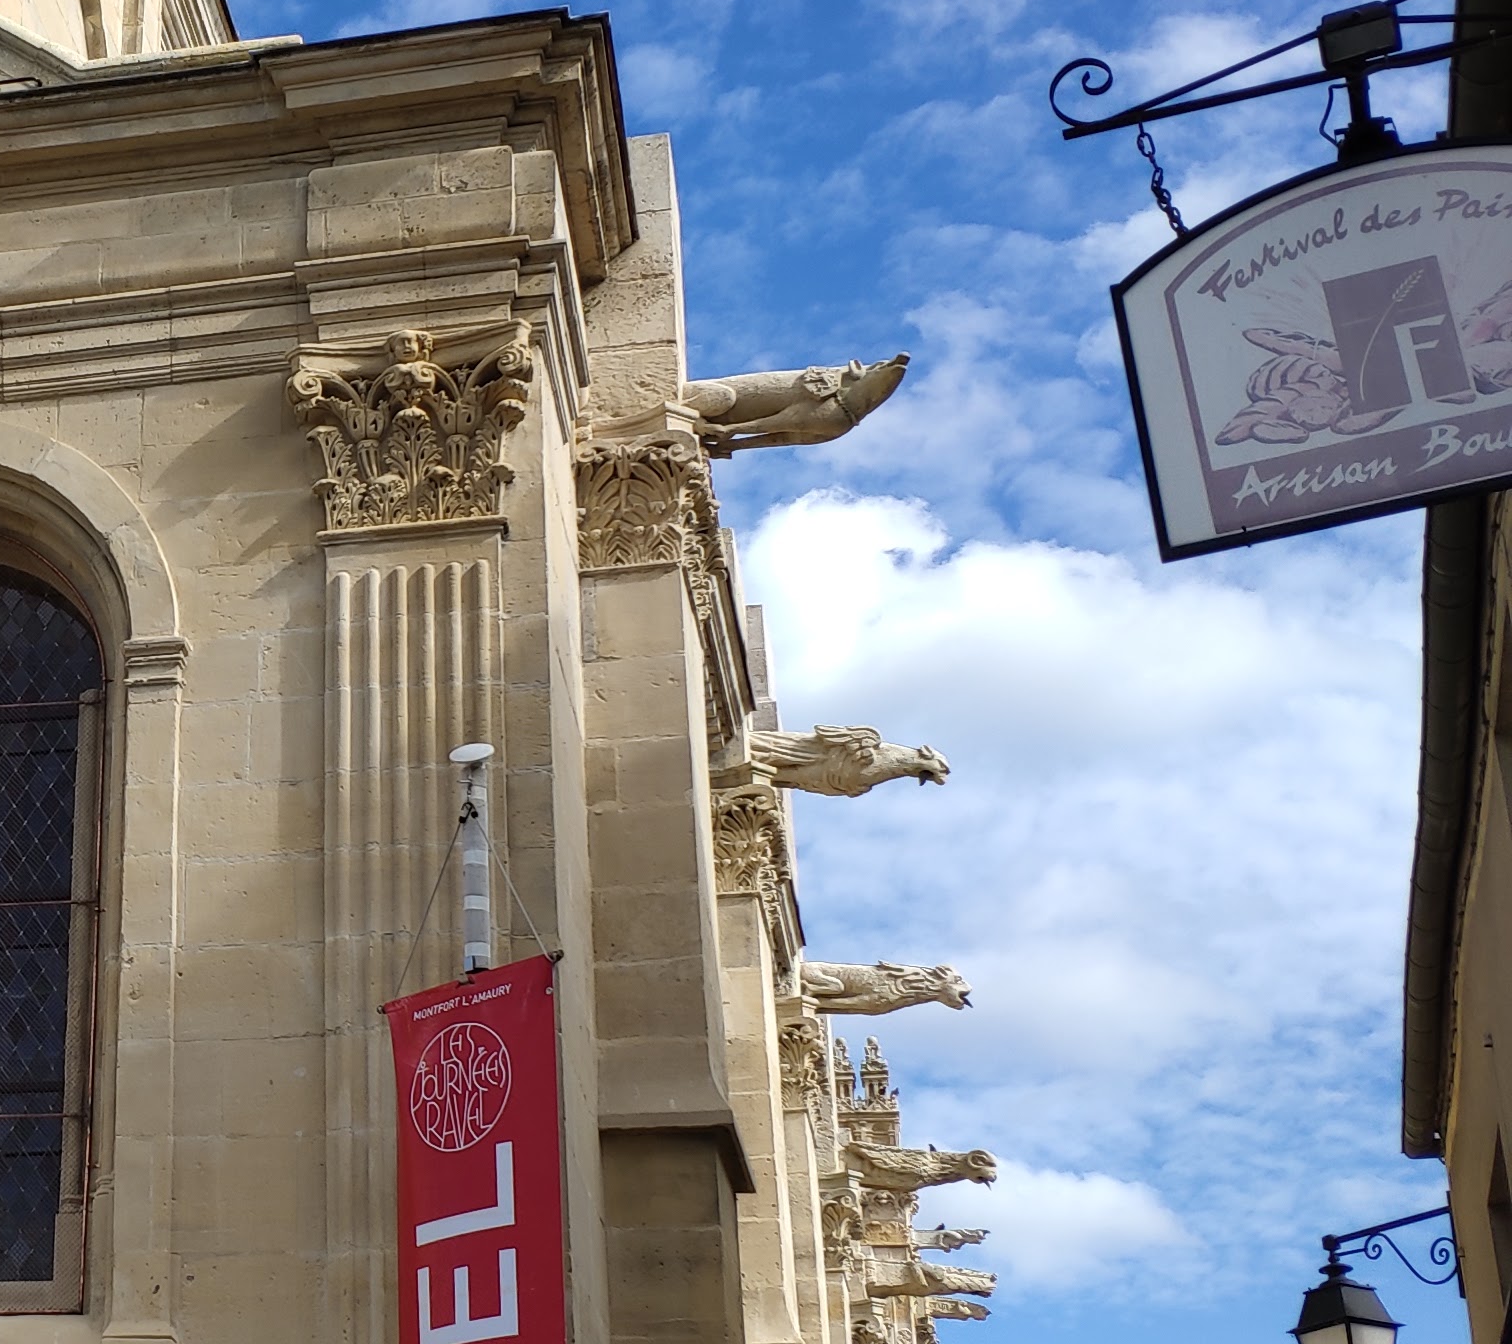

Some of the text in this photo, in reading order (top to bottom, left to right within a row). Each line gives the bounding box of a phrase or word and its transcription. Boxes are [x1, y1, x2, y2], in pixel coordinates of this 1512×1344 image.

[1197, 208, 1348, 303] Festival
[1360, 203, 1422, 234] des
[1392, 313, 1446, 400] F
[1232, 457, 1398, 509] Artisan
[413, 983, 513, 1022] MONTFORT L'AMAURY
[440, 1024, 475, 1065] LES
[426, 1089, 493, 1150] RAVEL
